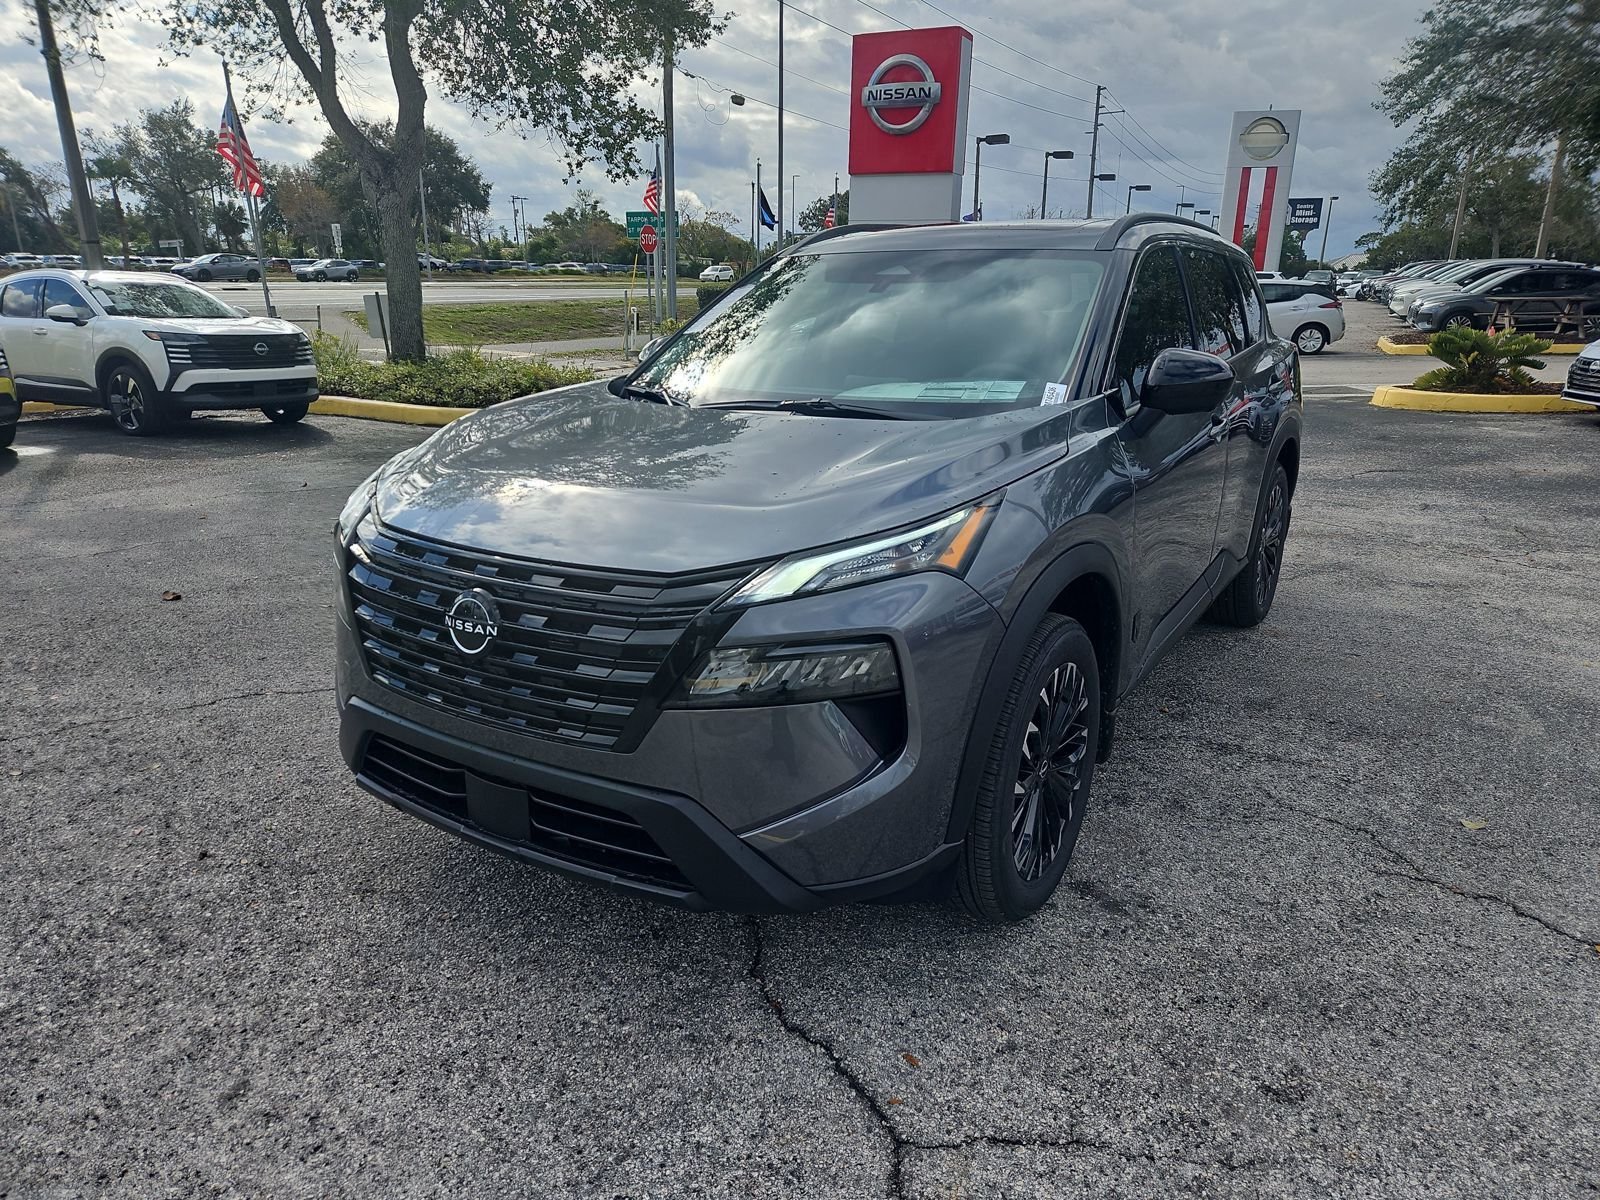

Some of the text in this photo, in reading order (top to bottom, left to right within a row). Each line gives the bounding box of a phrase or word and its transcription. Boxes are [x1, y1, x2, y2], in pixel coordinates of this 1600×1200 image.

[867, 86, 932, 102] NISSAN
[641, 233, 657, 245] STOP
[444, 615, 498, 636] NISSAN
